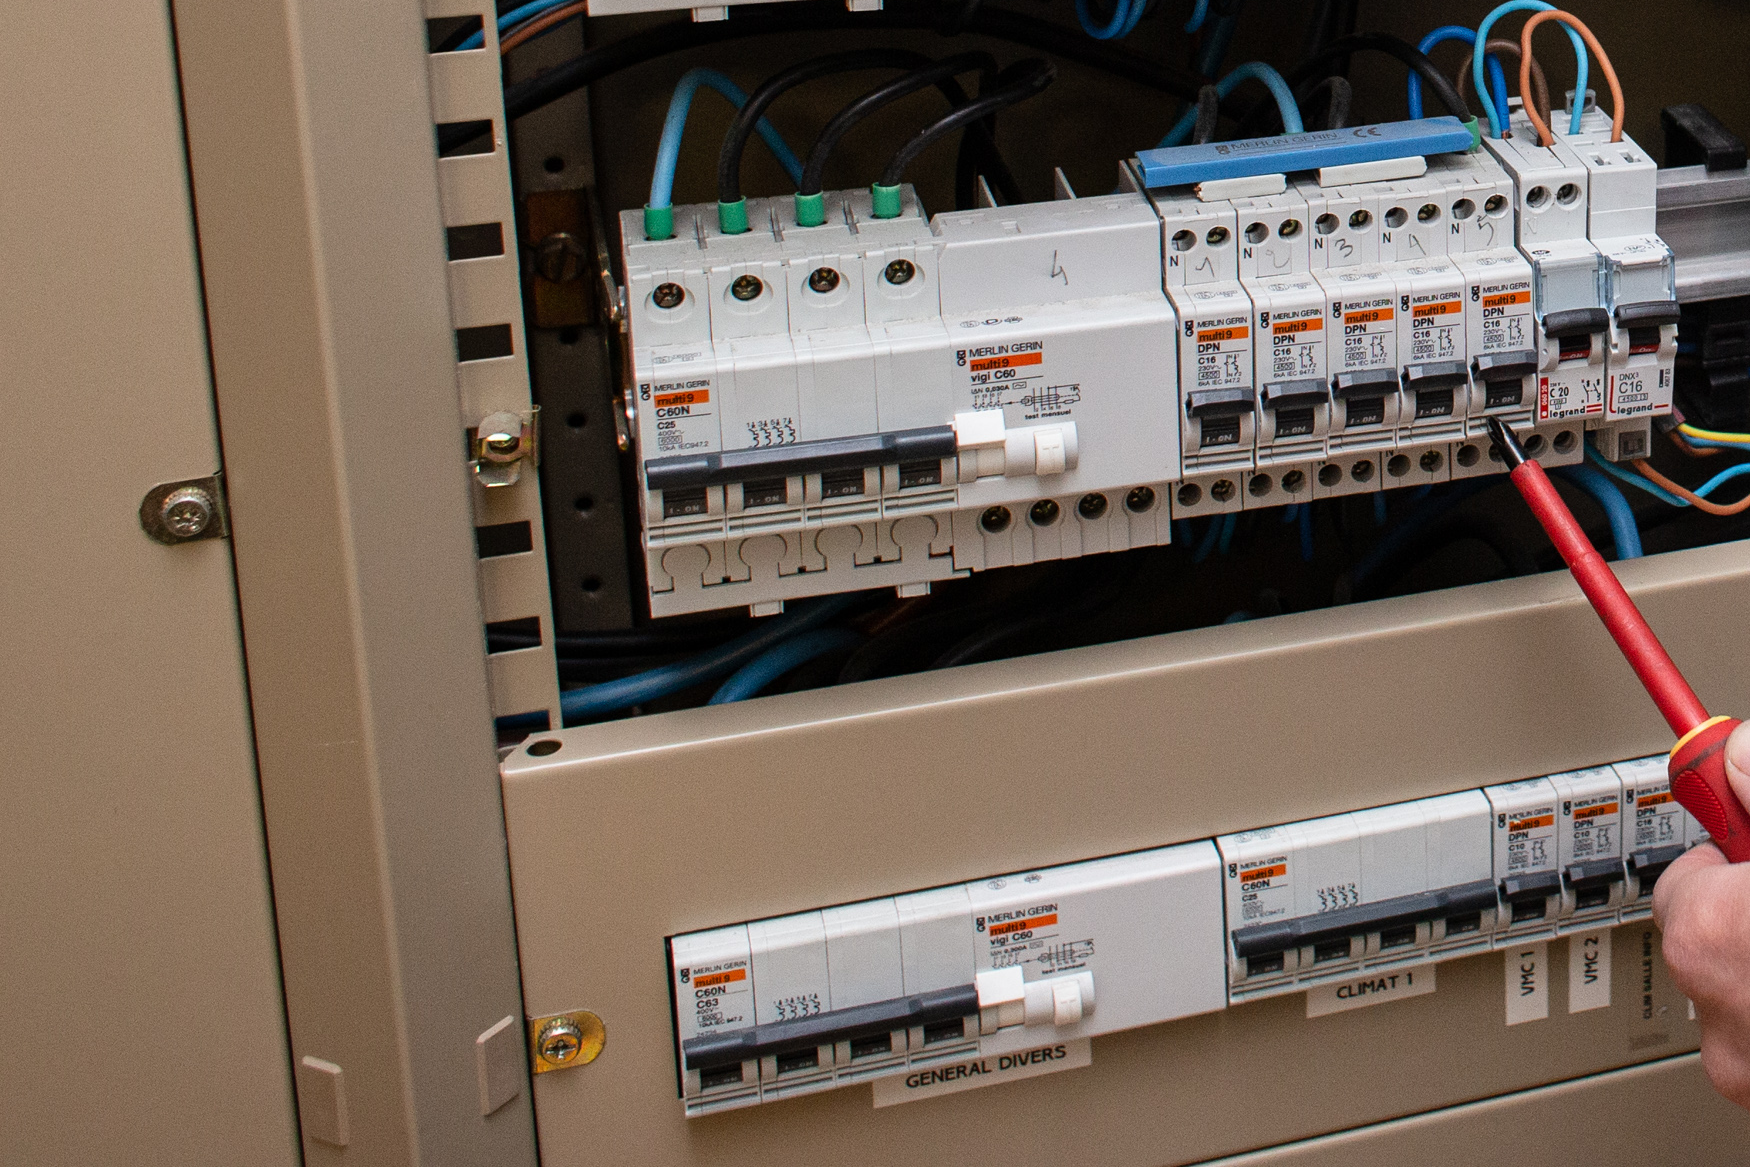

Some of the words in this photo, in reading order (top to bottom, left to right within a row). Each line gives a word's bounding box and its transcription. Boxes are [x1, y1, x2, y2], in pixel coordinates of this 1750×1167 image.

[1334, 238, 1354, 258] 3
[1483, 307, 1505, 318] DPN
[1483, 320, 1500, 328] C16
[969, 345, 1009, 357] MERLIN
[1011, 341, 1043, 353] GERIN
[1197, 342, 1221, 353] DPN
[1198, 356, 1216, 365] C16
[970, 371, 991, 384] vigi
[994, 369, 1016, 379] C60
[654, 382, 685, 392] MERLIN
[686, 379, 710, 388] GERIN
[1558, 386, 1570, 397] 20
[1619, 380, 1643, 394] C16
[656, 406, 690, 418] C60N
[1550, 405, 1586, 418] legrand
[1617, 403, 1653, 415] legrand
[657, 420, 676, 430] C25
[1508, 831, 1529, 842] DPN
[1242, 879, 1270, 892] C60N
[987, 909, 1026, 923] MERLIN
[1027, 903, 1058, 915] GERIN
[989, 934, 1009, 946] vigi
[1012, 930, 1033, 941] C60
[1584, 936, 1599, 947] 2
[1520, 950, 1535, 958] 1
[693, 965, 722, 975] MERLIN
[724, 960, 747, 970] GERIN
[1584, 949, 1598, 985] VMC
[1336, 975, 1400, 999] CLIMAT
[1407, 972, 1413, 986] 1
[1520, 962, 1535, 996] VMC
[695, 985, 726, 998] C60N
[696, 998, 719, 1009] C63
[906, 1060, 992, 1088] GENERAL
[998, 1045, 1067, 1071] DIVERS
